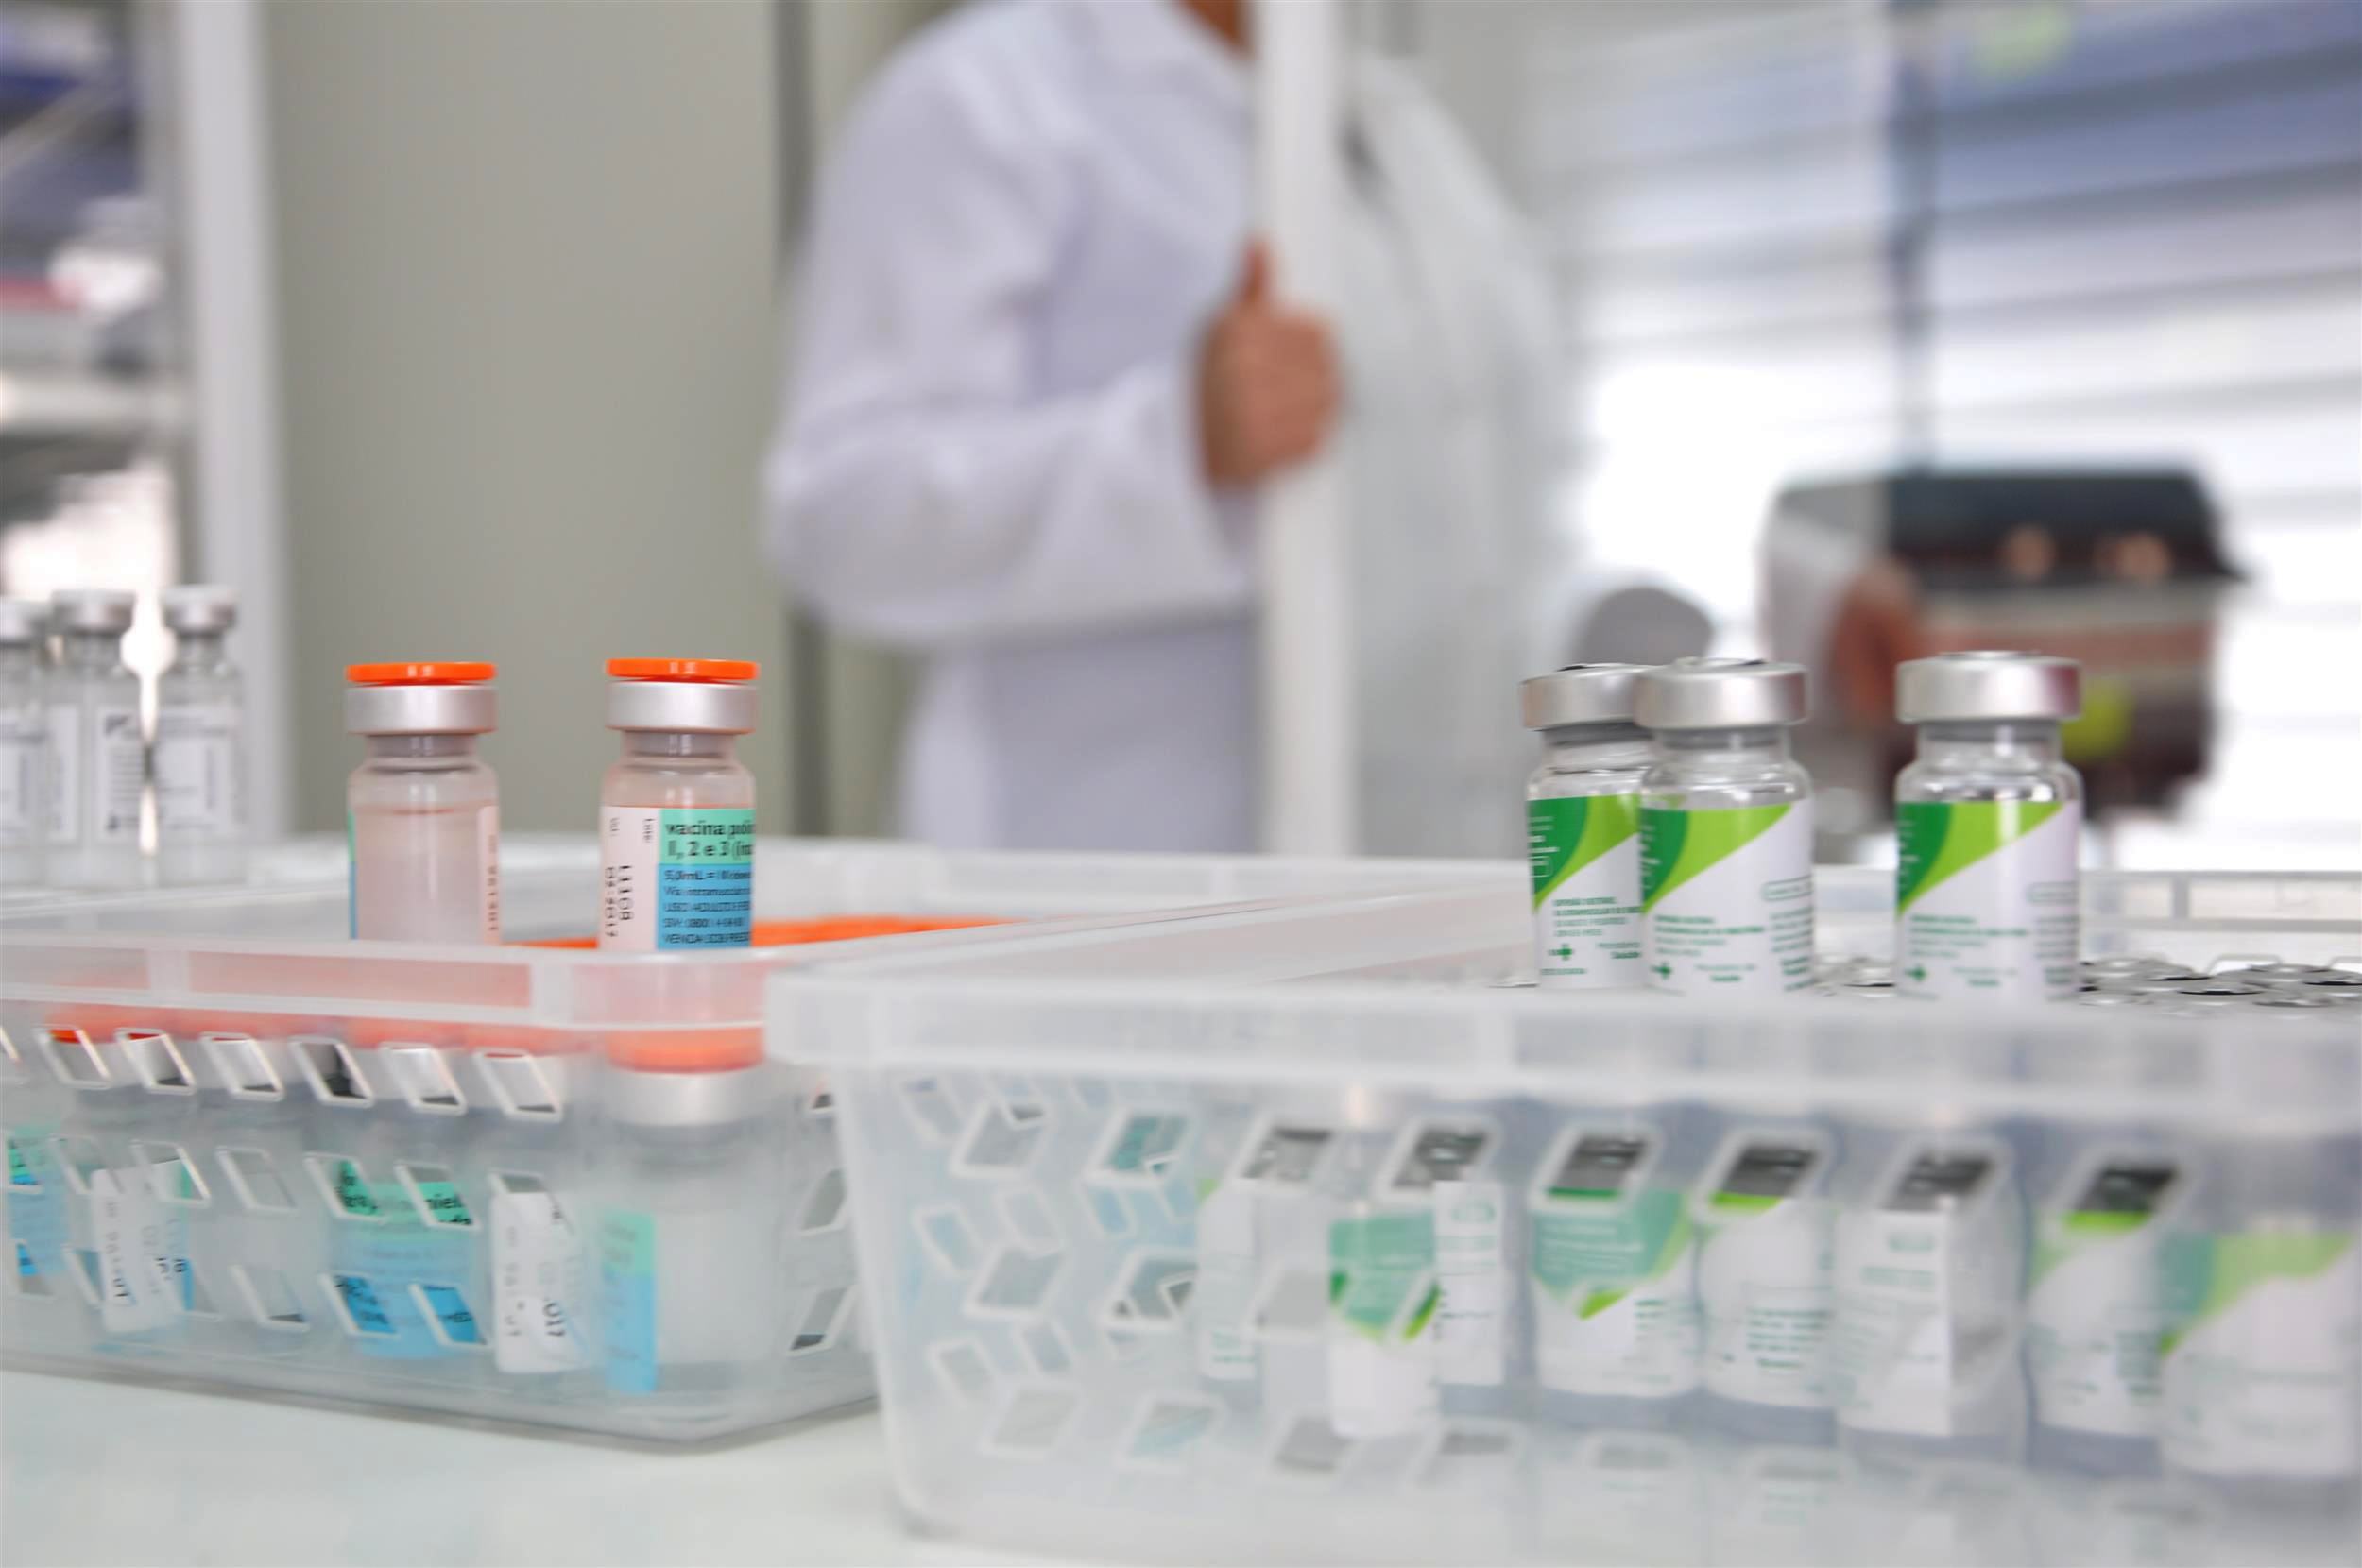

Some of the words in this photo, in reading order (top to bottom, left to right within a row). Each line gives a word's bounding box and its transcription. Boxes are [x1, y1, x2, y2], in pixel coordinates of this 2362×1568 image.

[665, 820, 726, 835] vacina
[686, 840, 700, 857] 2
[703, 845, 716, 857] e
[719, 840, 731, 857] 3
